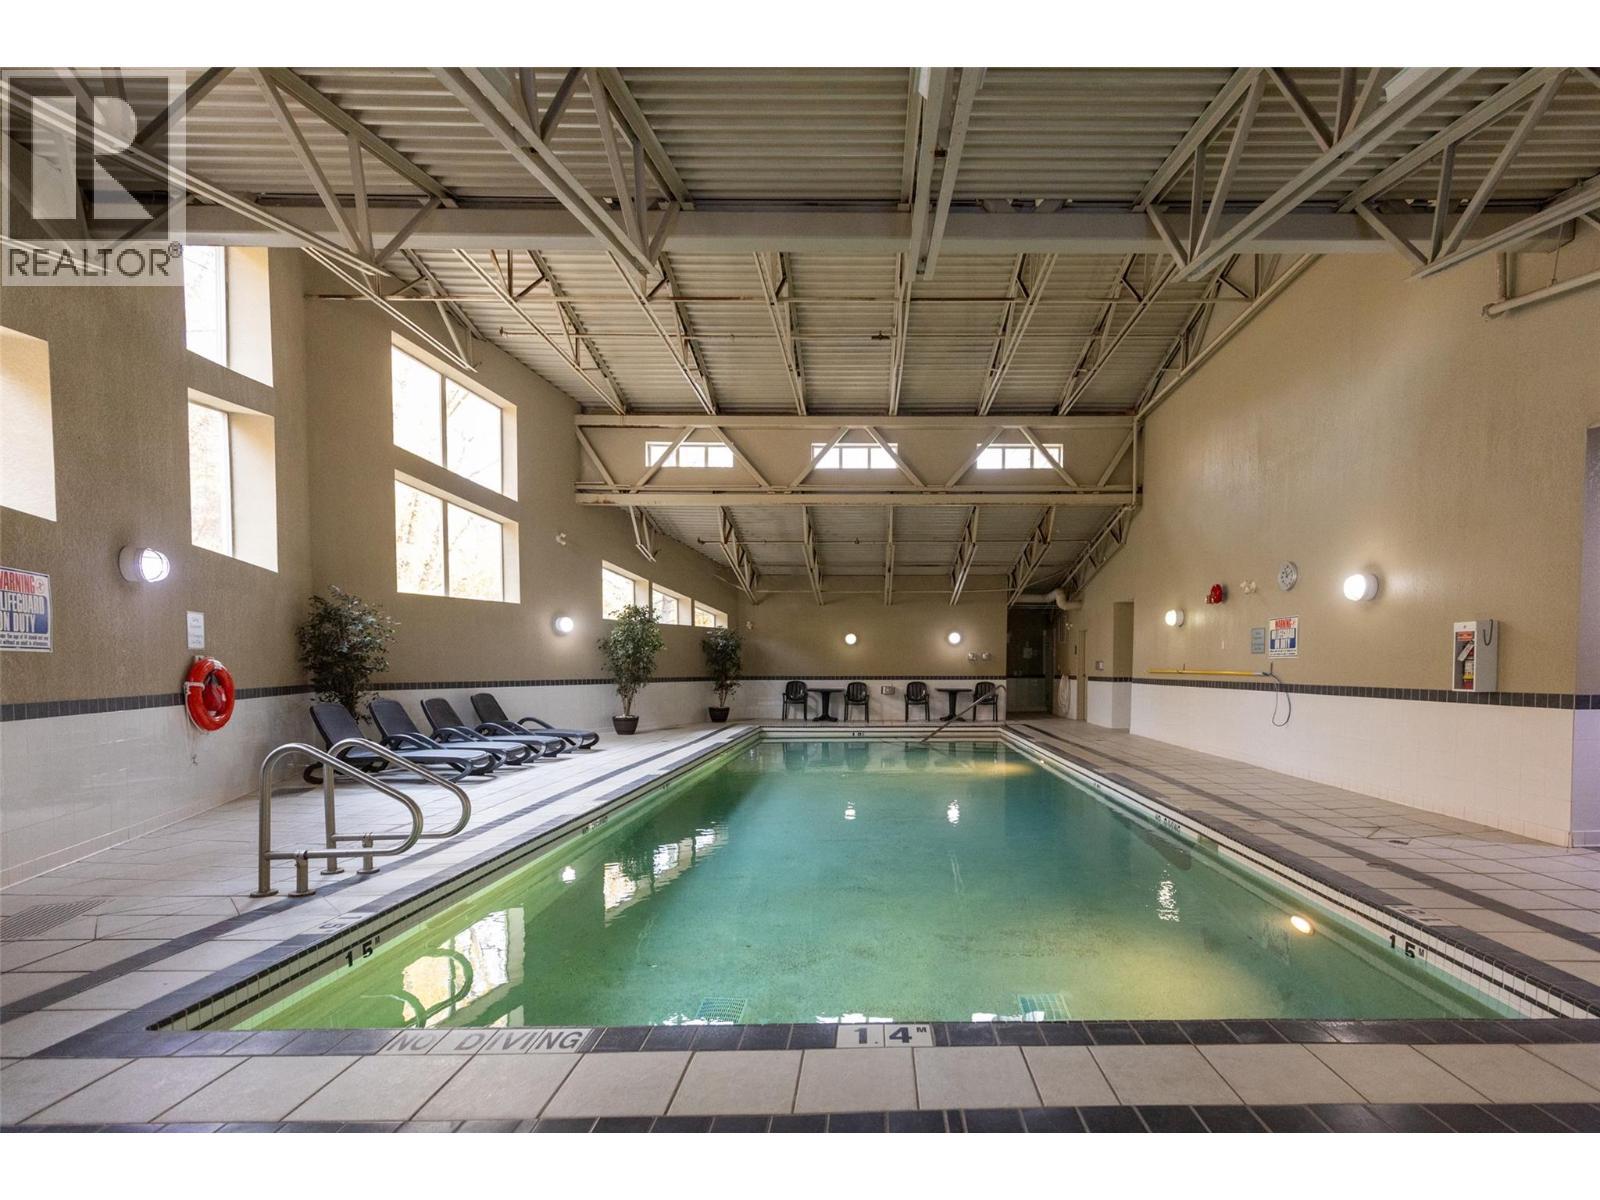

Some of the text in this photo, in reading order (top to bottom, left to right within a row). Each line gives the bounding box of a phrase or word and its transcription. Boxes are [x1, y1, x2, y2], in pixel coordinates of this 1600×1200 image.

[13, 613, 36, 633] DUTY
[386, 1031, 584, 1051] NO DIVING
